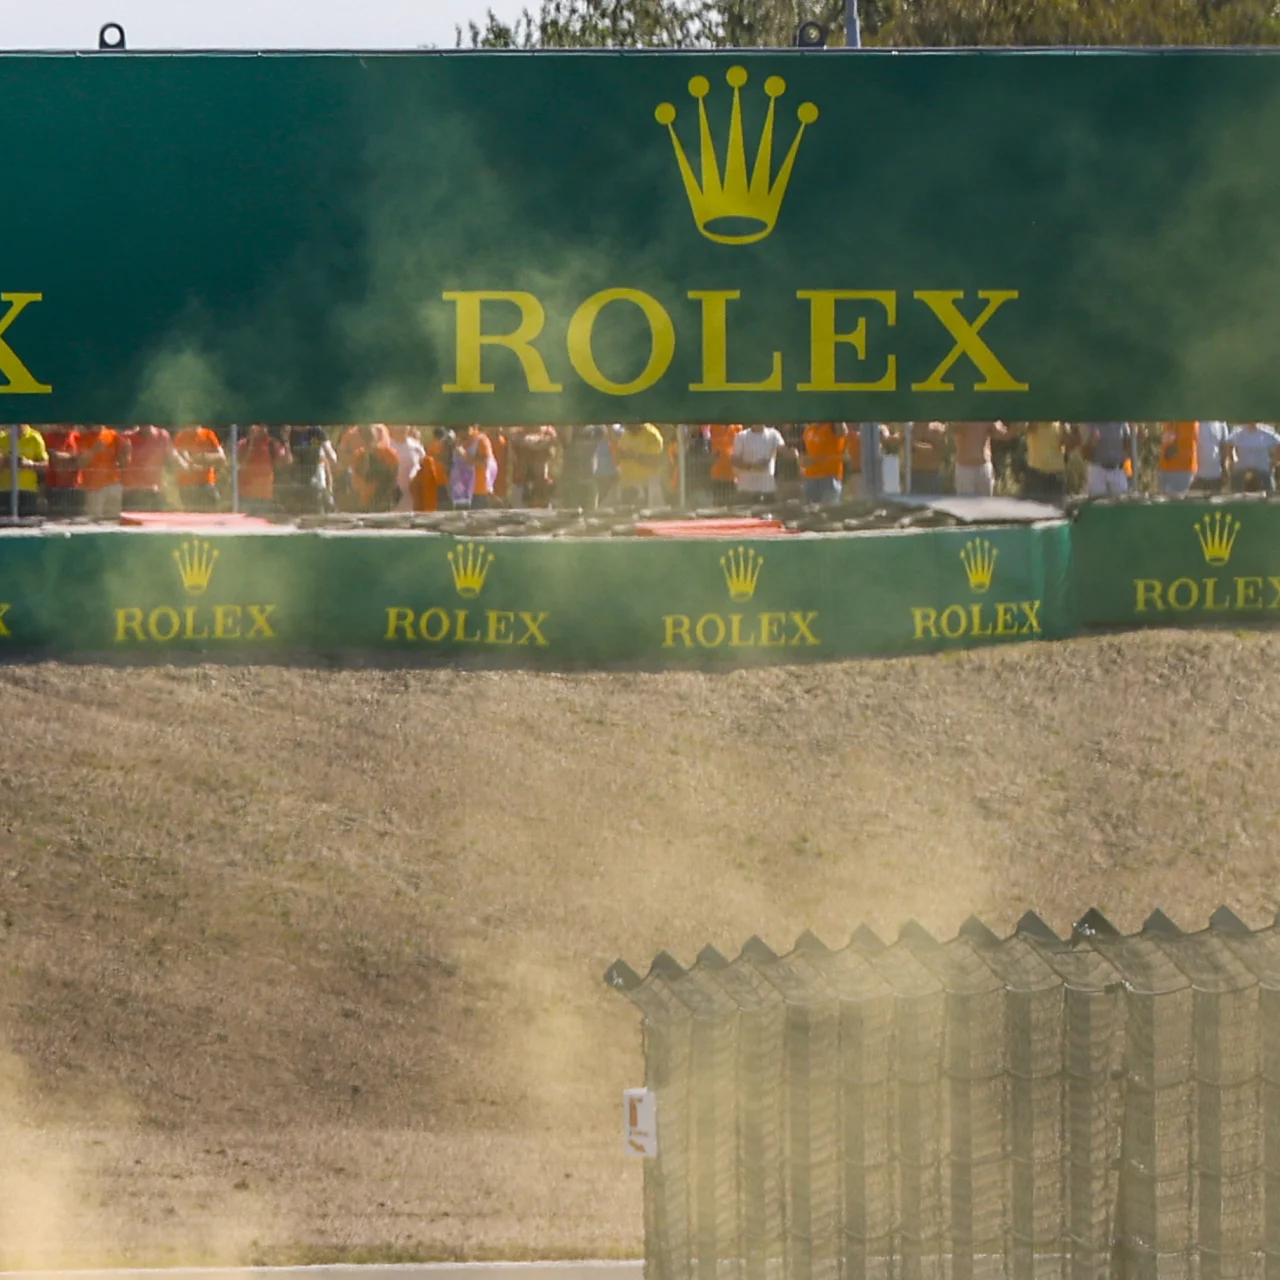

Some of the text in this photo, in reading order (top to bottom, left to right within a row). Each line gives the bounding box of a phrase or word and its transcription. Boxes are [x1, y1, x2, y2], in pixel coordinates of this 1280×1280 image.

[440, 286, 1030, 397] ROLEX
[113, 603, 276, 643] ROLEX
[384, 606, 549, 647] ROLEX
[662, 610, 820, 648] ROLEX
[911, 600, 1042, 641] ROLEX
